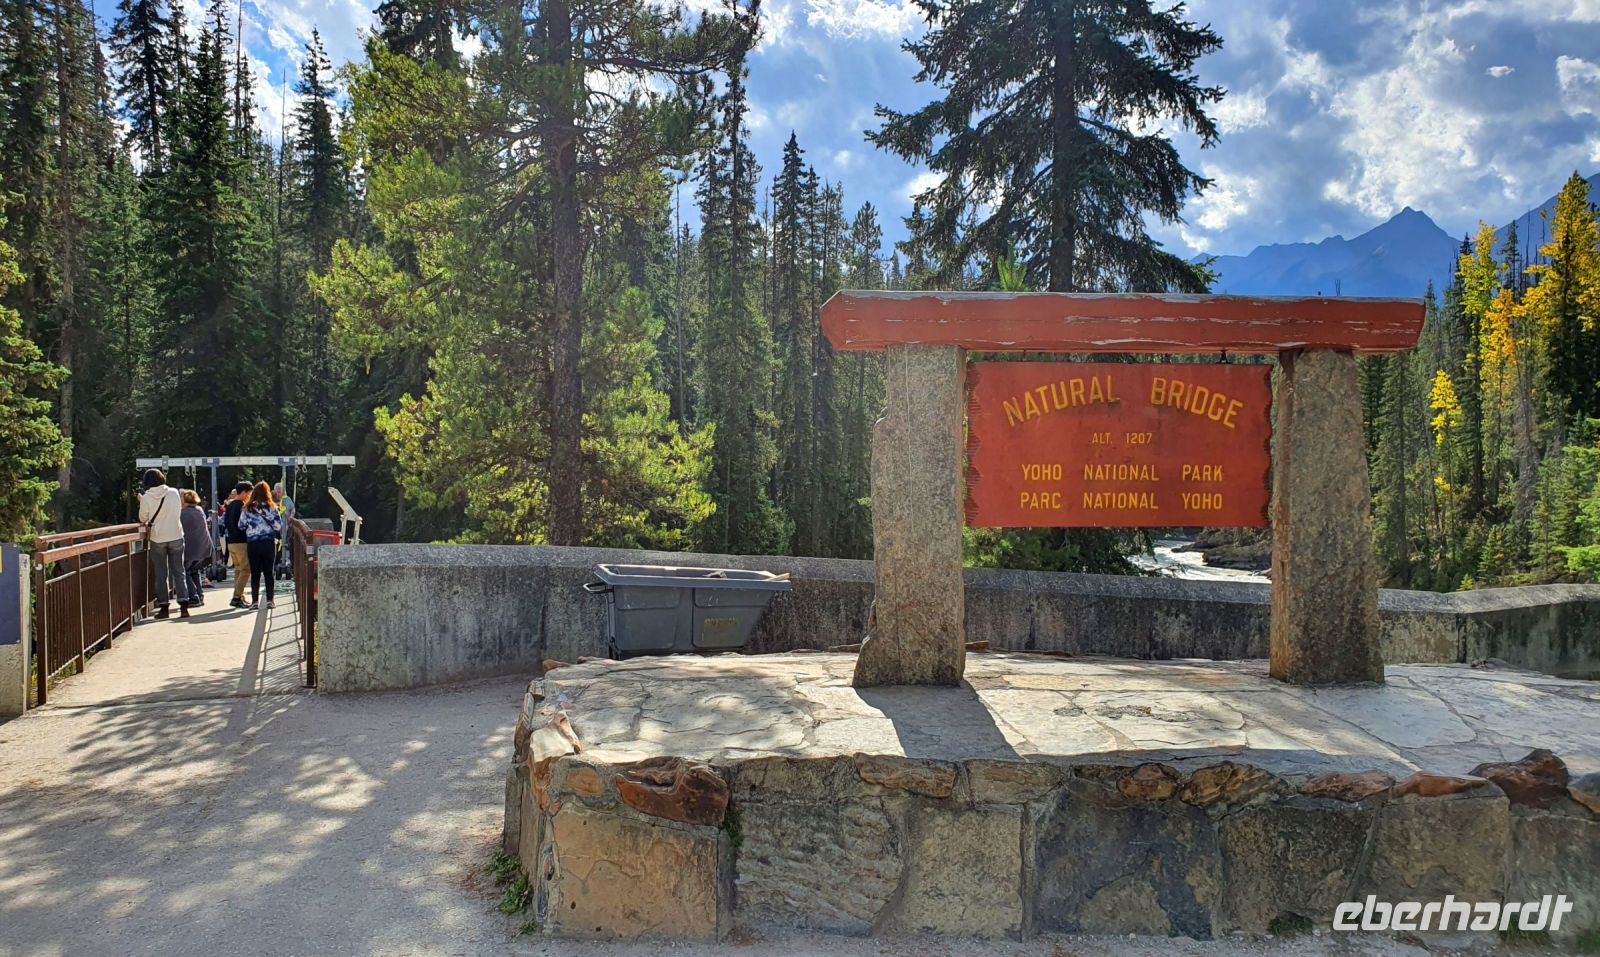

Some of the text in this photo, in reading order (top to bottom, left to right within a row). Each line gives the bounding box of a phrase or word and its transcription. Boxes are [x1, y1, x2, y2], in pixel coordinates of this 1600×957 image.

[1003, 375, 1244, 429] NATURAL BRIDGE
[1126, 432, 1153, 444] 1207
[1021, 464, 1223, 481] YOHO NATIONAL PARK
[1020, 492, 1223, 510] PARC NATIONAL YOHO
